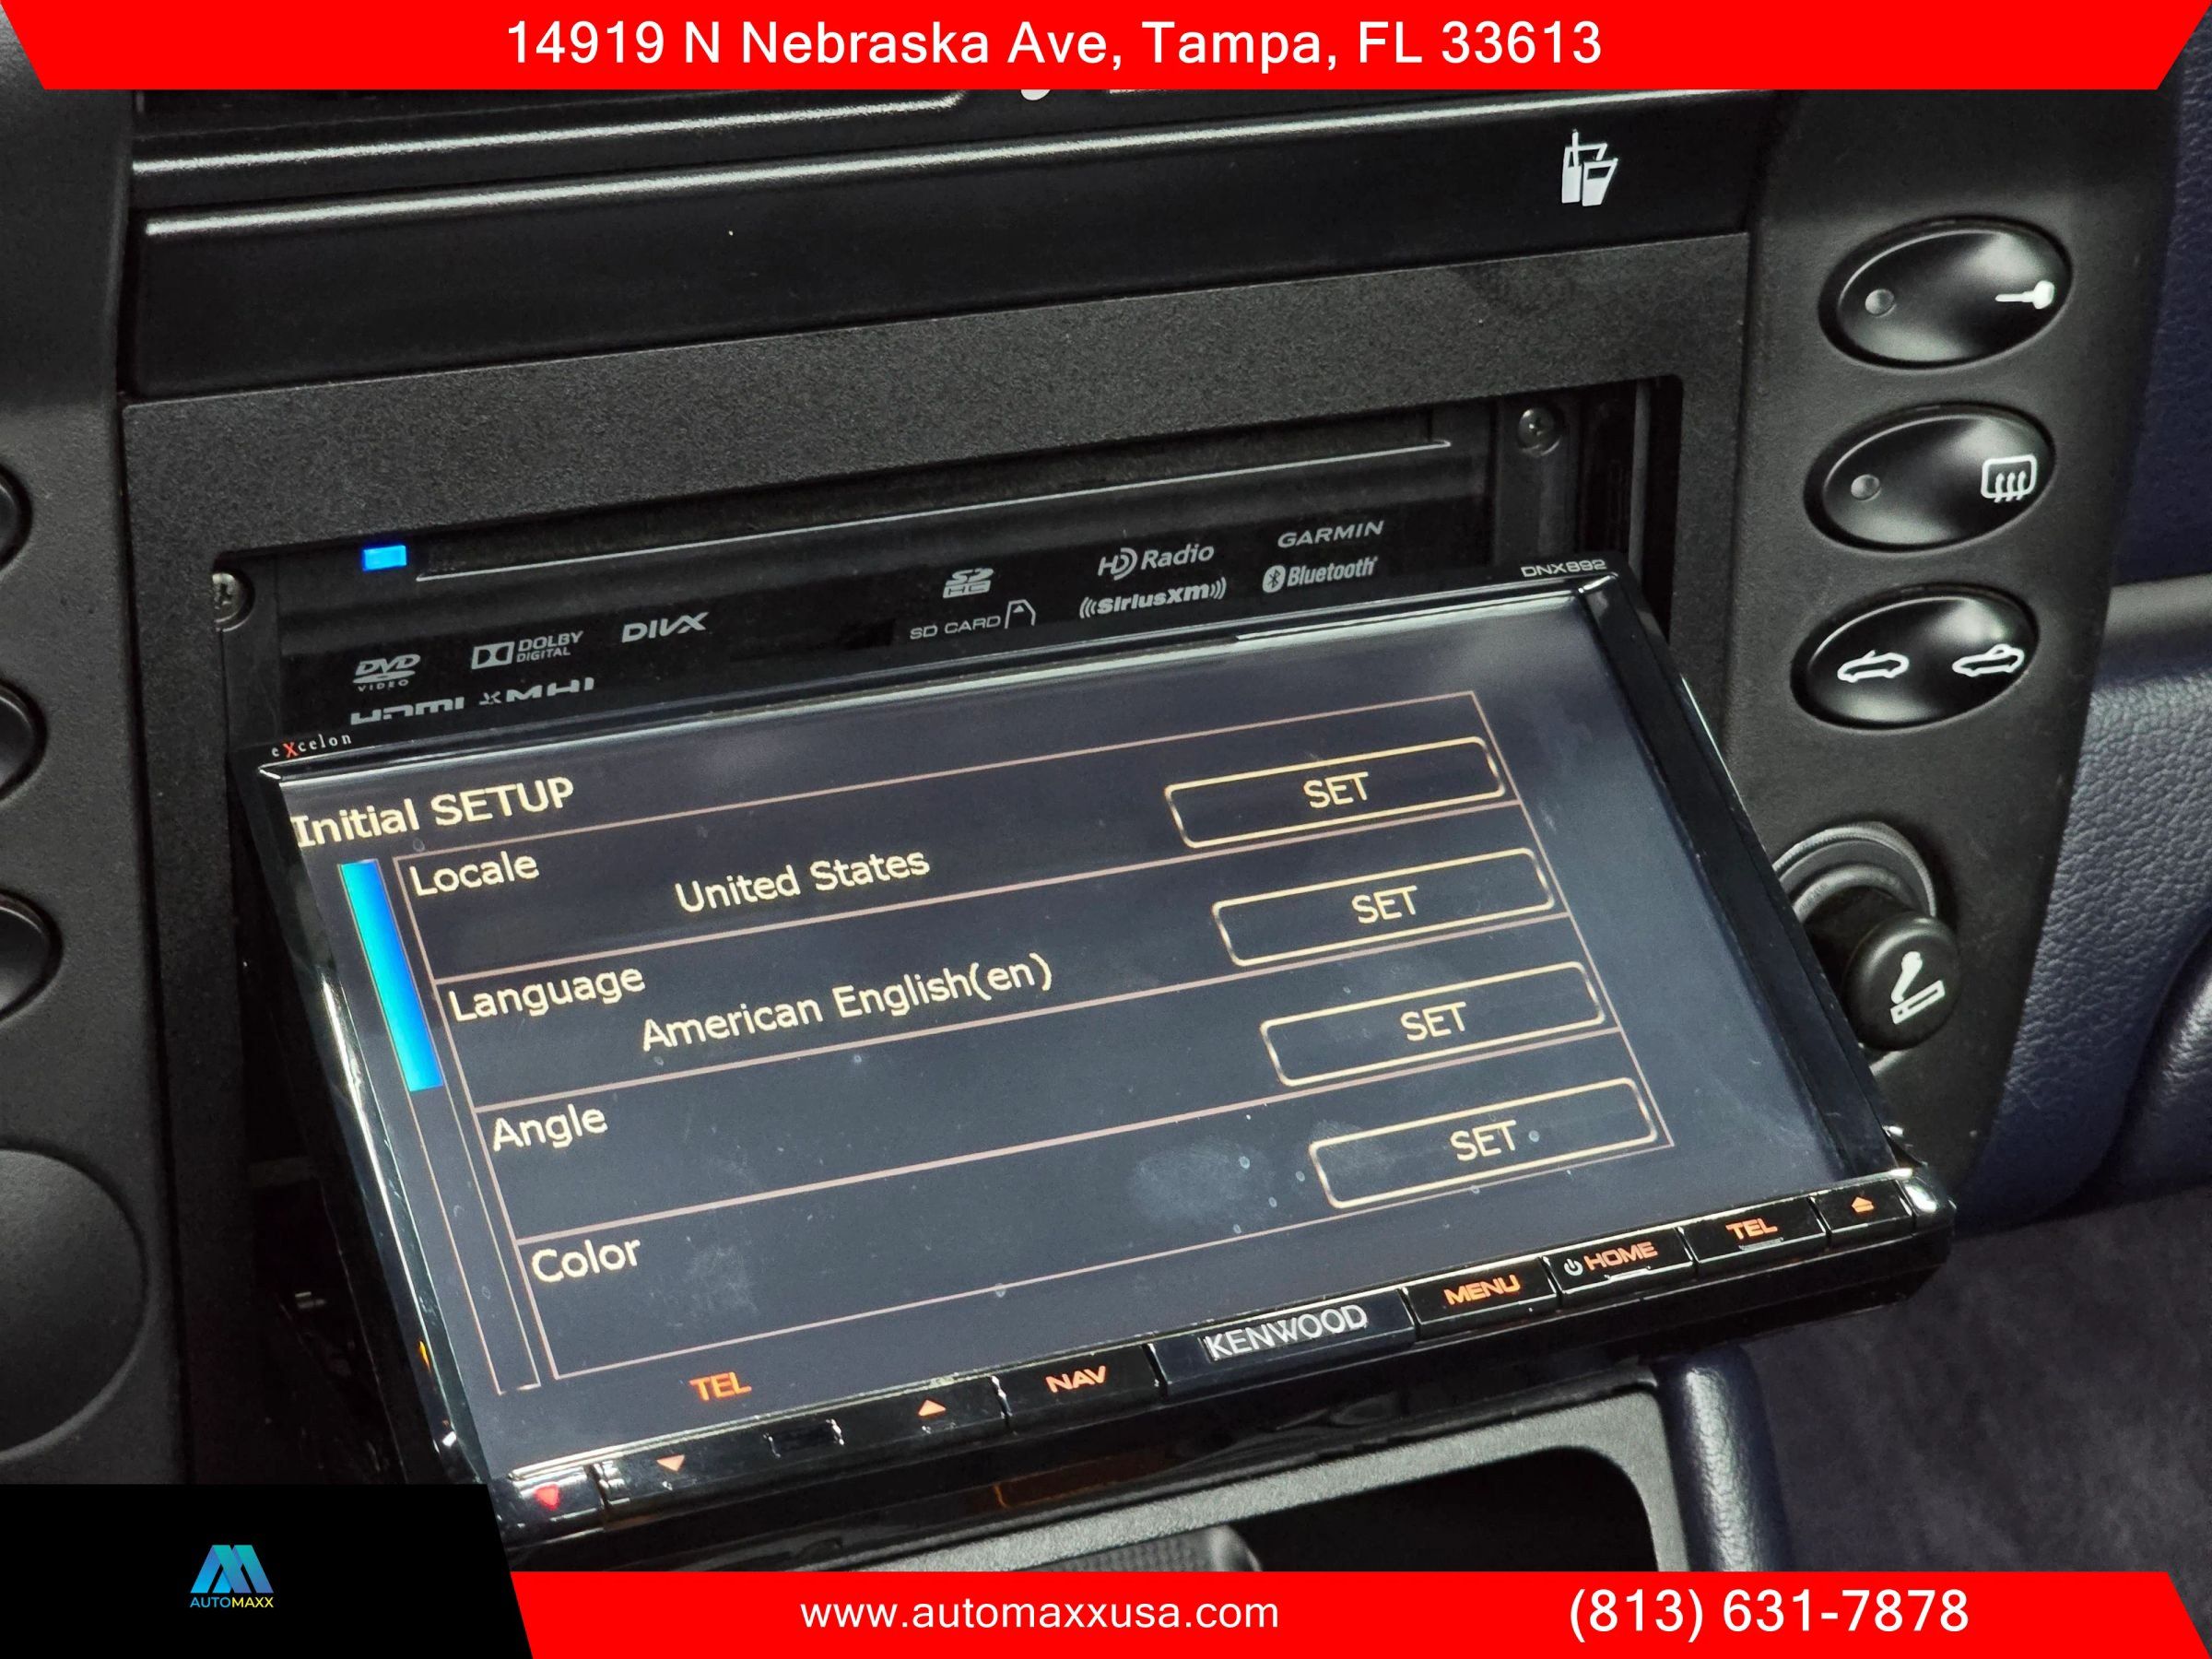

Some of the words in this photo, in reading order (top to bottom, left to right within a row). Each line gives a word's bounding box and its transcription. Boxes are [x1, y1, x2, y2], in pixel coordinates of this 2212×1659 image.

[1277, 520, 1384, 548] GARMIN
[1140, 543, 1215, 571] Radio
[1521, 559, 1607, 578] DNX892
[517, 630, 583, 653] DOLBY
[910, 624, 938, 639] SD
[945, 615, 1002, 634] CARD
[354, 653, 421, 677] DVD
[516, 645, 571, 664] DIGITAL
[358, 678, 409, 692] VIDEO
[1302, 771, 1370, 809] SET
[289, 797, 420, 847] Initial
[429, 776, 574, 827] SETUP
[410, 851, 540, 897] Locale
[675, 864, 801, 913] United
[810, 850, 931, 892] States
[1351, 885, 1418, 924] SET
[448, 963, 646, 1022] Language
[642, 995, 824, 1052] American
[833, 953, 1053, 1018] English(en)
[1400, 1001, 1467, 1041] SET
[490, 1102, 608, 1152] Angle
[1450, 1120, 1517, 1162] SET
[1724, 1218, 1778, 1241] TEL
[530, 1235, 641, 1284] Color
[1583, 1241, 1658, 1271] HOME
[1443, 1274, 1521, 1306] MENU
[1205, 1305, 1369, 1360] KENWOOD
[688, 1371, 753, 1402] TEL
[1045, 1365, 1107, 1394] NAV
